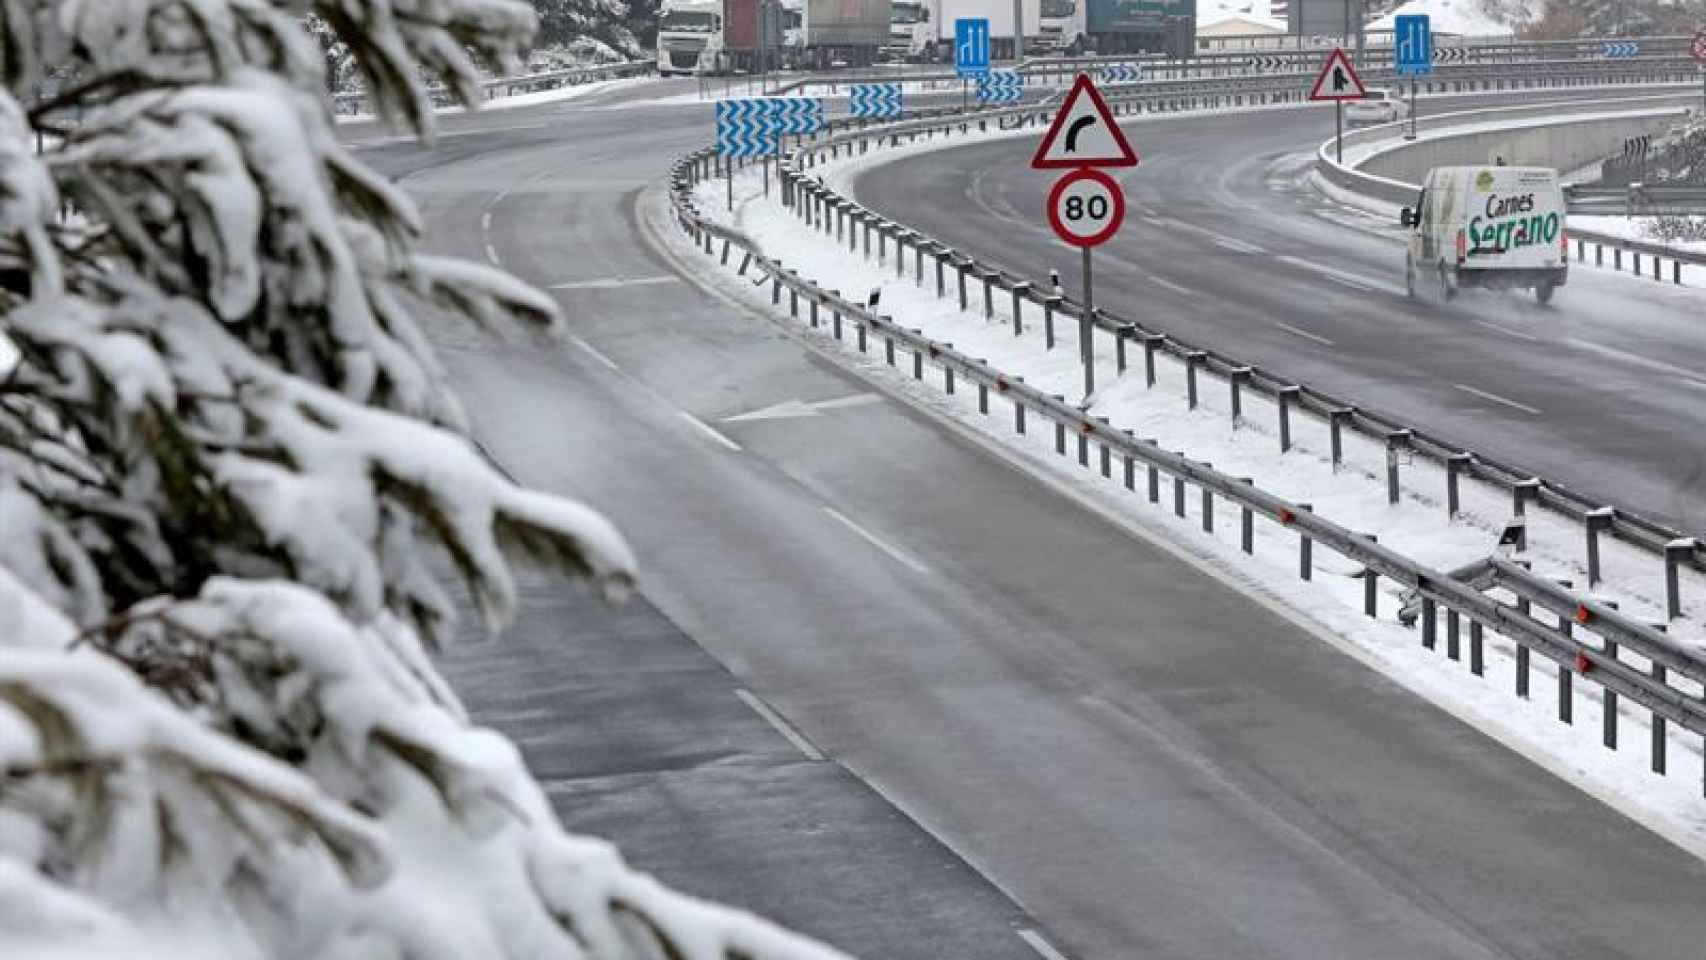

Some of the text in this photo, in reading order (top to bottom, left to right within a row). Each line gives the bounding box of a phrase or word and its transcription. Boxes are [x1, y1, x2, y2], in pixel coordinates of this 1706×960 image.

[1065, 195, 1107, 220] 80
[1486, 193, 1535, 218] Carnes
[1467, 212, 1559, 255] Serrano
